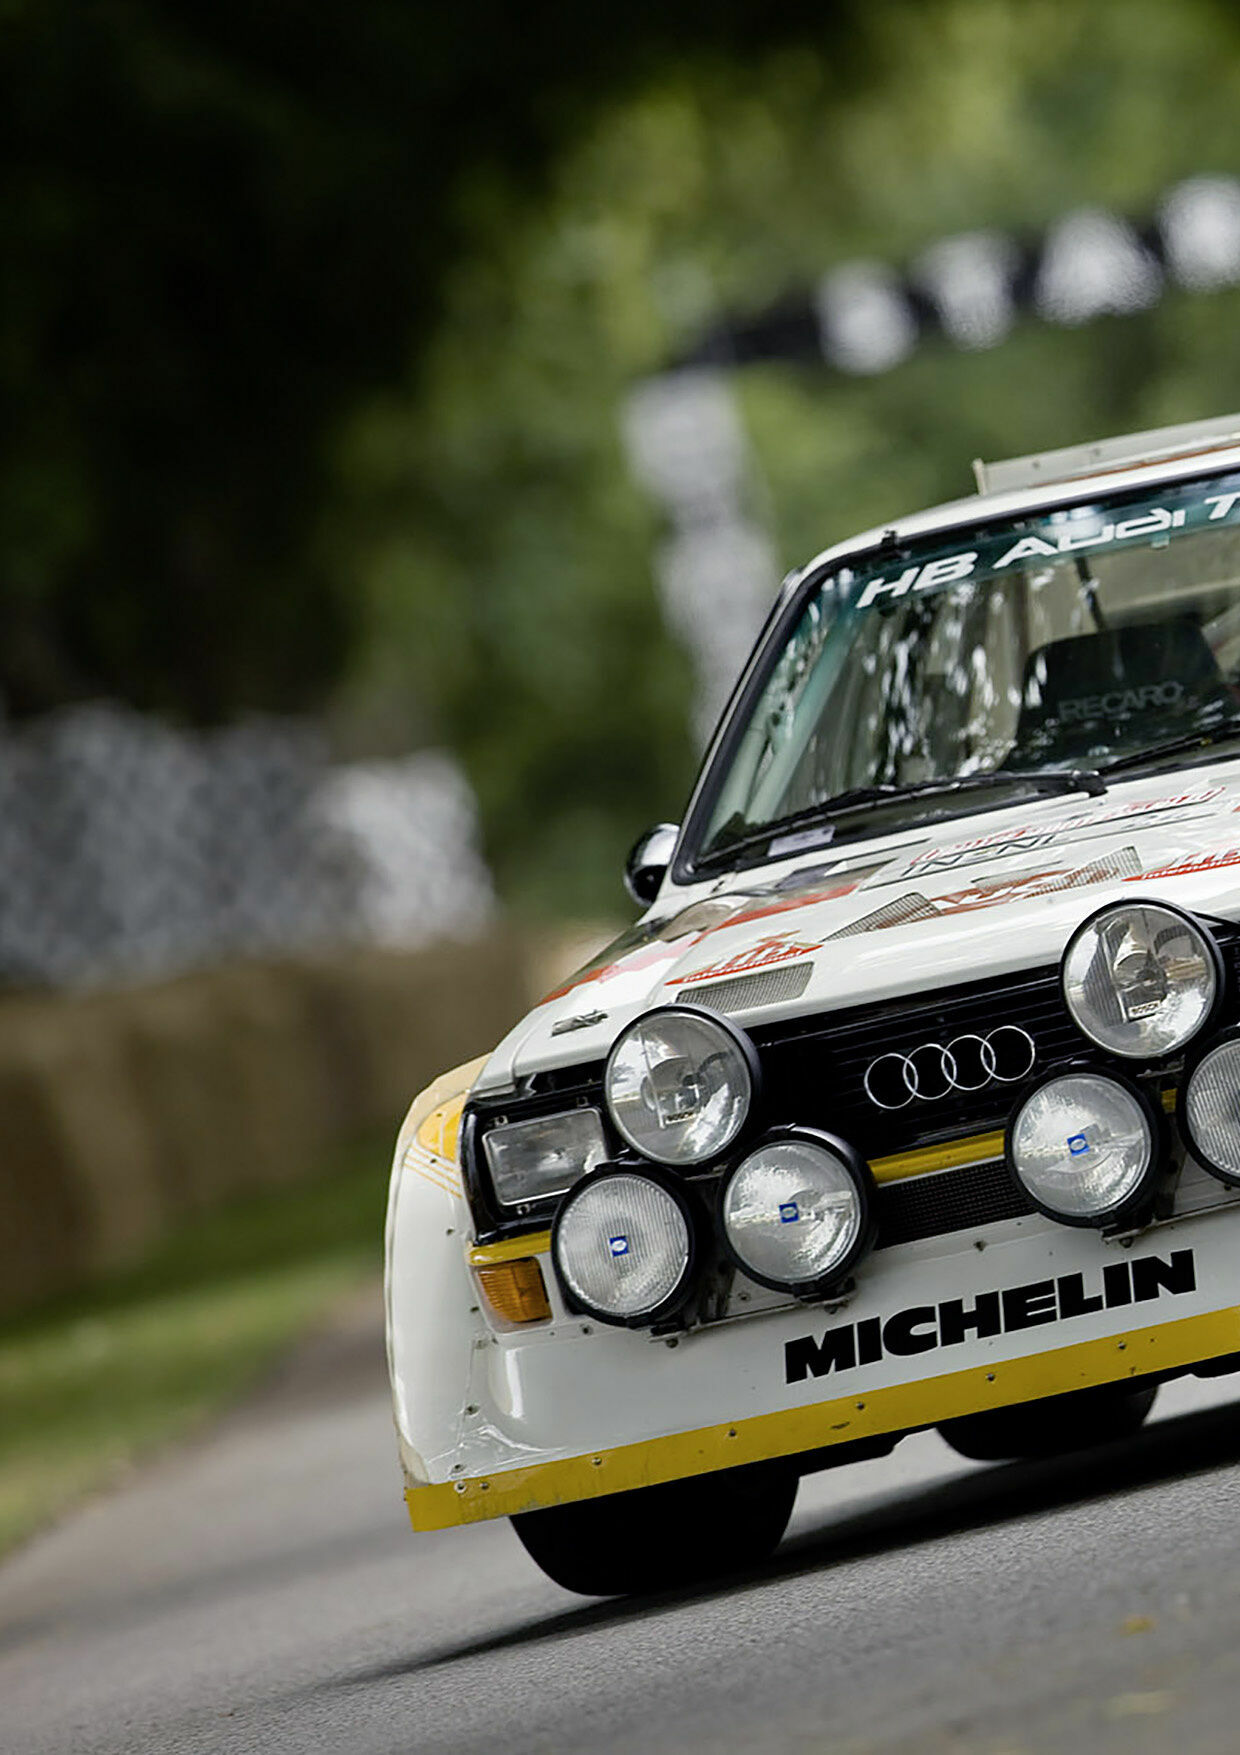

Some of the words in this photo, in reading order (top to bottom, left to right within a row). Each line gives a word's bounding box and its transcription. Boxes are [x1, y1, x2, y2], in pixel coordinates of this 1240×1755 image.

[858, 553, 977, 609] HB
[1058, 680, 1185, 721] RECARO
[785, 1249, 1197, 1384] MICHELIN
